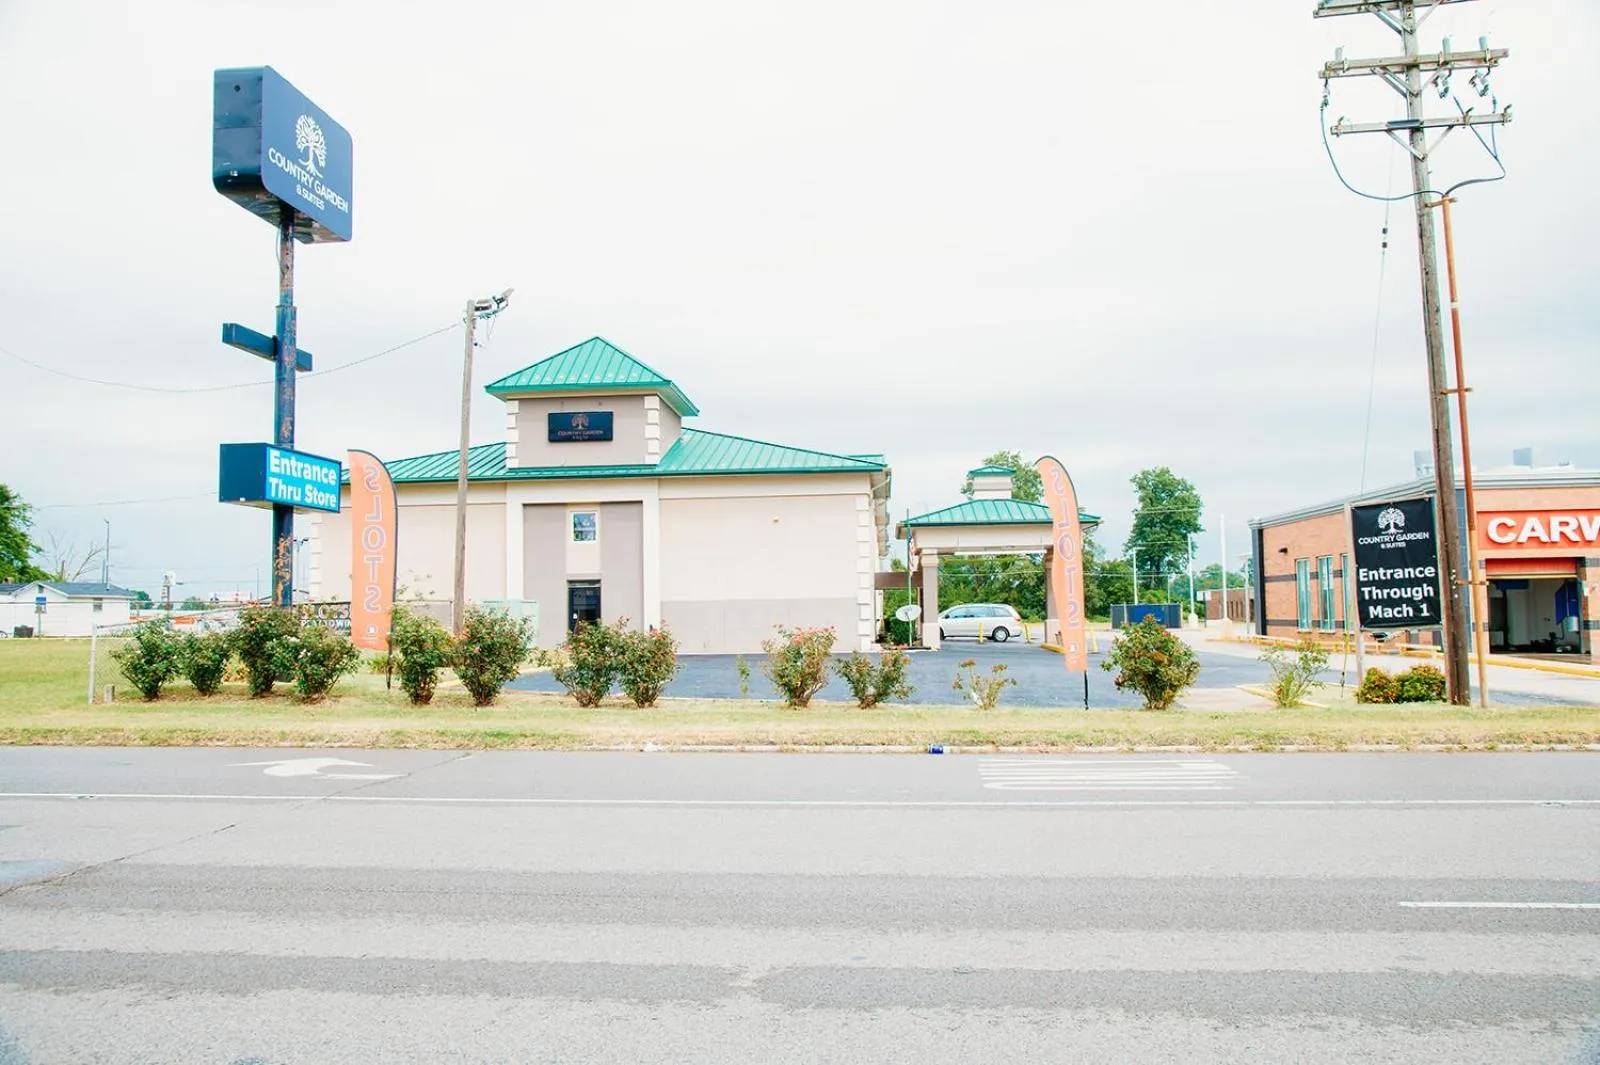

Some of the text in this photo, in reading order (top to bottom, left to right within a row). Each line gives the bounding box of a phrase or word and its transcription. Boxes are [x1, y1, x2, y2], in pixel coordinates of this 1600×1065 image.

[268, 147, 349, 214] COUNTRY GARDEN
[296, 184, 325, 210] & SUITES
[269, 448, 337, 485] Entrance
[269, 476, 337, 508] Thru Store
[1358, 531, 1430, 545] COUNTRY GARDEN
[1358, 566, 1436, 582] Entrance
[1360, 584, 1434, 601] Through
[1368, 603, 1431, 619] Mach 1
